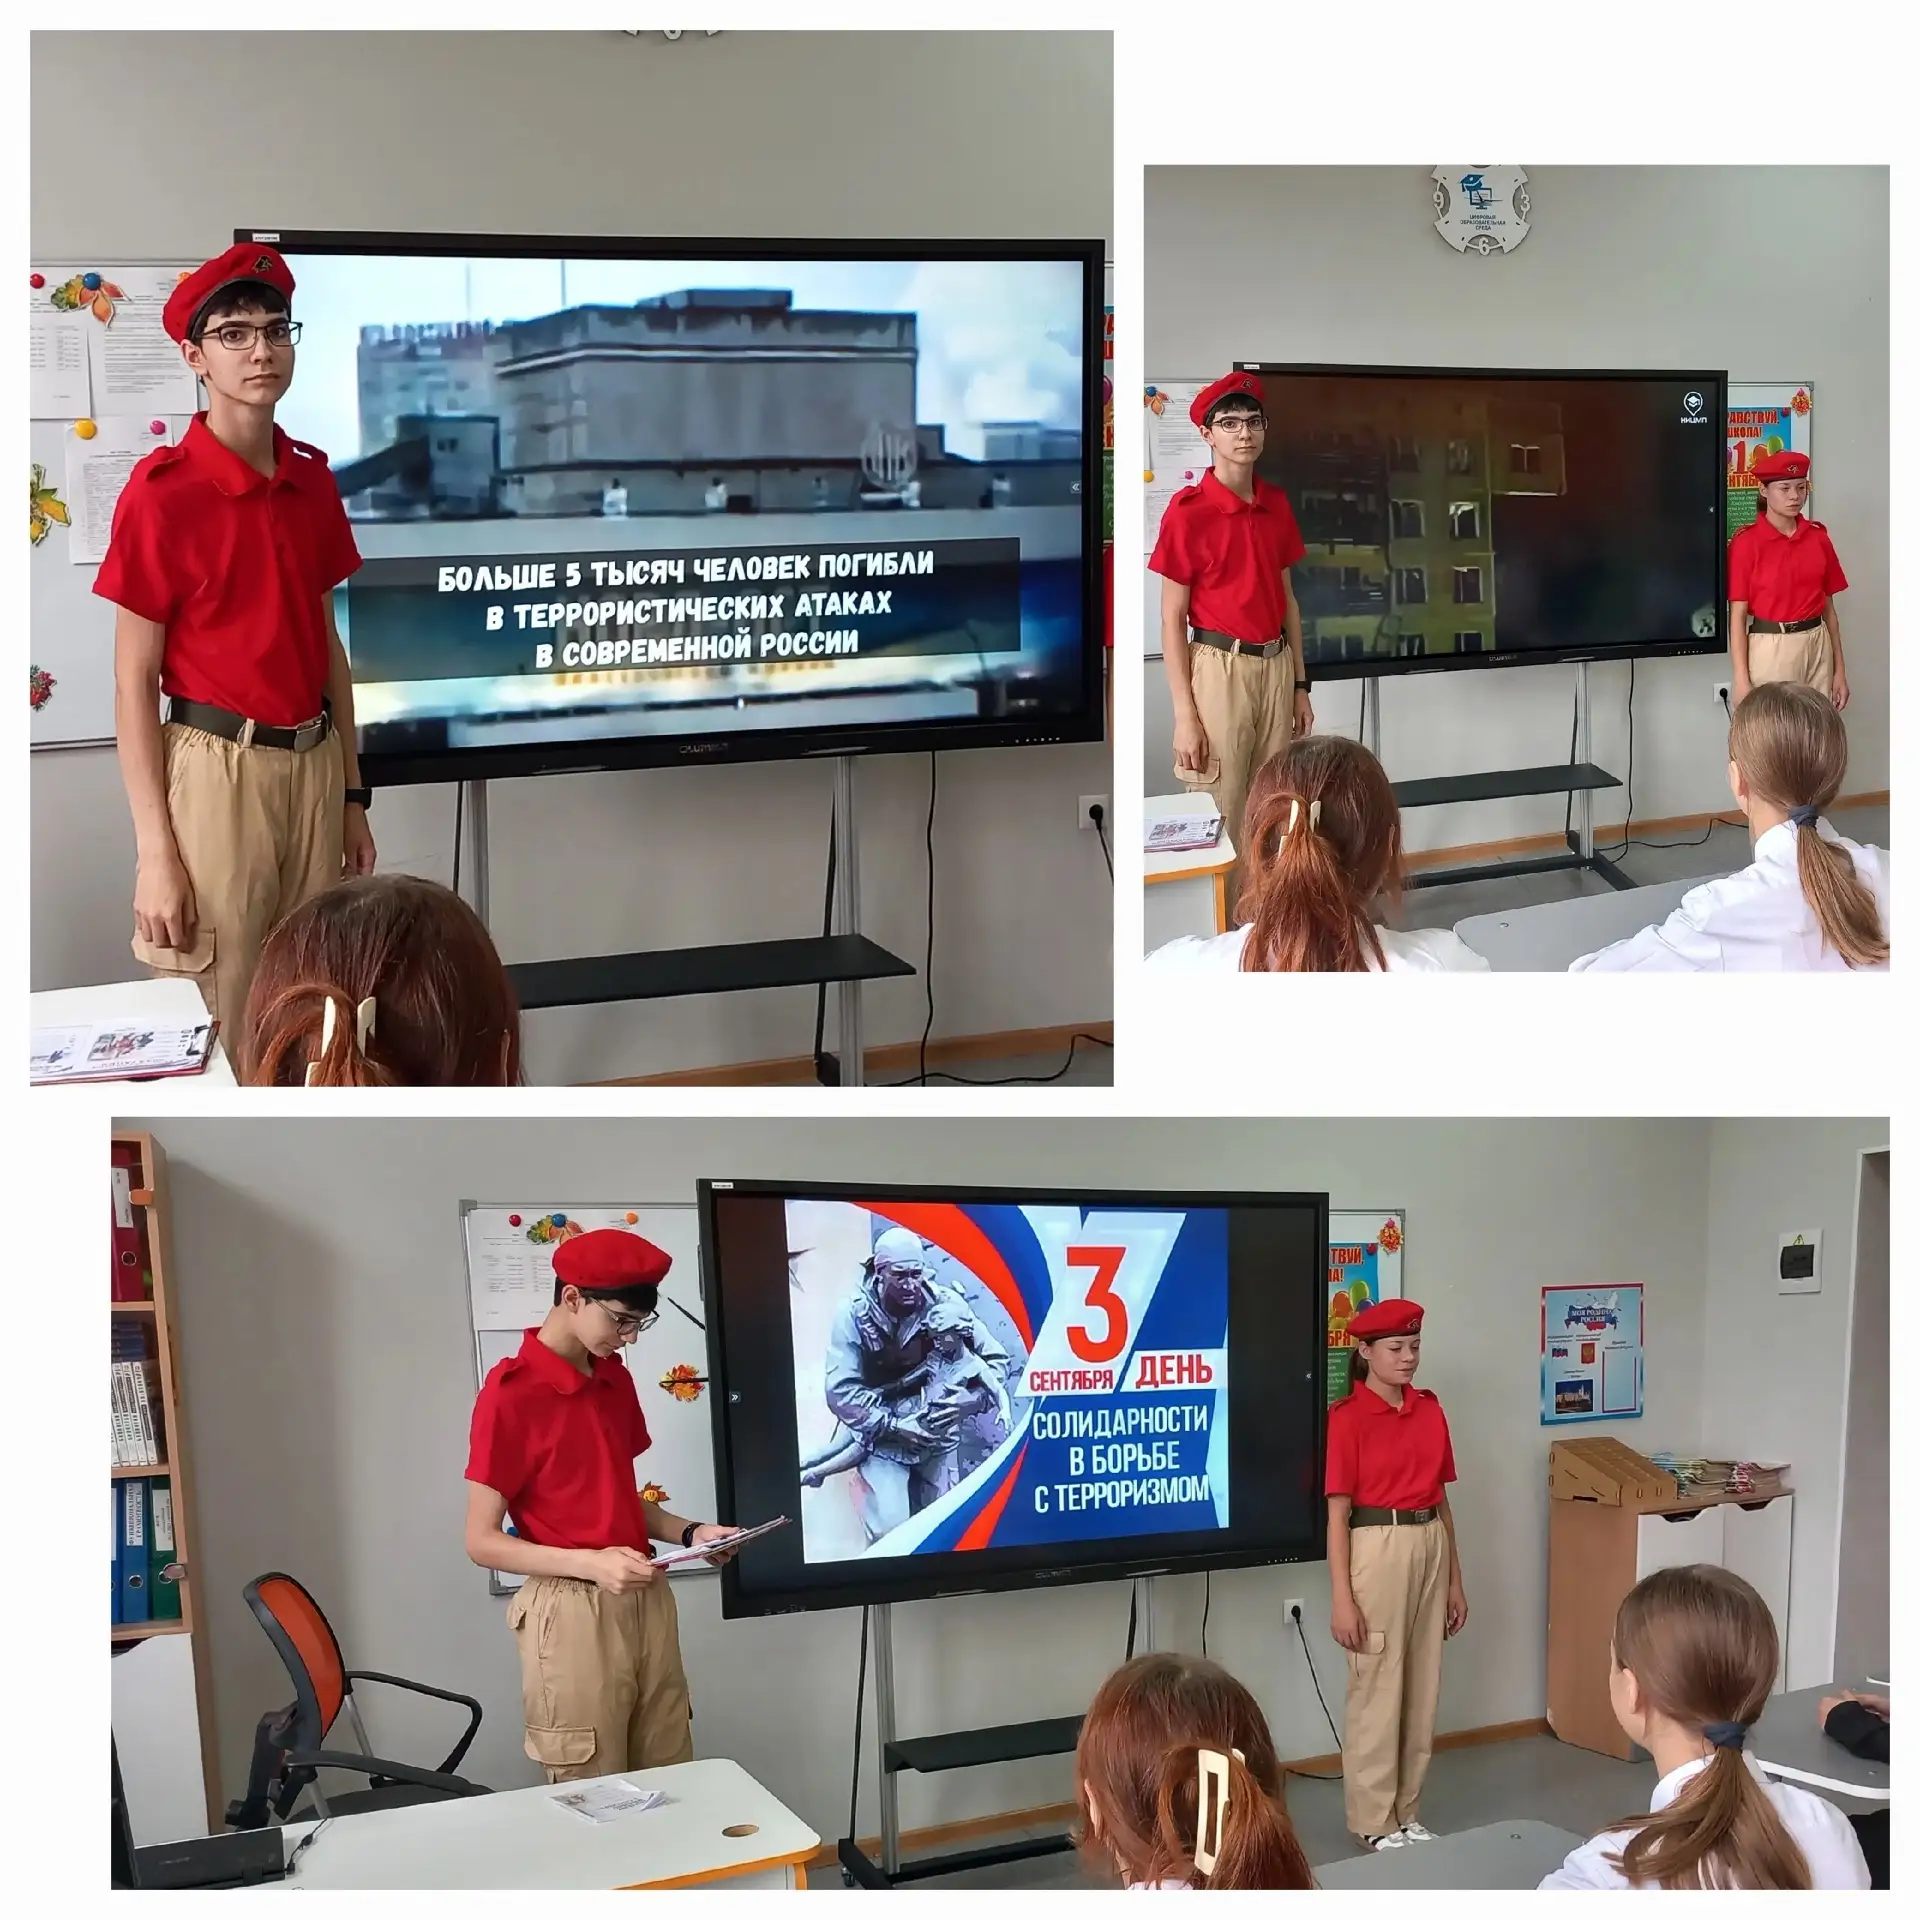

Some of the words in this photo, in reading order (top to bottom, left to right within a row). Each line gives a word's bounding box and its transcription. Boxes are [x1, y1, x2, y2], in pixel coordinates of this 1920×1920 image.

[1433, 191, 1444, 208] 9
[1520, 194, 1530, 212] 3
[1479, 237, 1490, 255] 6
[1728, 408, 1780, 424] АВСТВУЙ,
[438, 562, 556, 592] БОЛЬШЕ
[566, 562, 582, 588] 5
[591, 559, 686, 587] ТЫСЯЧ
[693, 554, 811, 583] ЧЕЛОВЕК
[818, 550, 935, 579] ПОГИБЛИ
[486, 605, 504, 631] В
[513, 593, 785, 630] ТЕРРОРИСТИЧЕСКИХ
[794, 590, 893, 618] АТАКАХ
[535, 643, 554, 669] В
[562, 626, 752, 667] СОВРЕМЕННОЙ
[760, 629, 859, 658] РОССИИ
[1066, 1246, 1128, 1363] 3
[1030, 1369, 1114, 1392] СЕНТЯБРЯ
[1135, 1354, 1213, 1389] ДЕНЬ
[1033, 1405, 1208, 1440] СОЛИДАРНОСТИ
[1070, 1447, 1085, 1476] В
[1092, 1440, 1181, 1475] БОРЬБЕ
[1034, 1486, 1049, 1513] С
[1054, 1475, 1210, 1512] ТЕРРОРИЗМОМ
